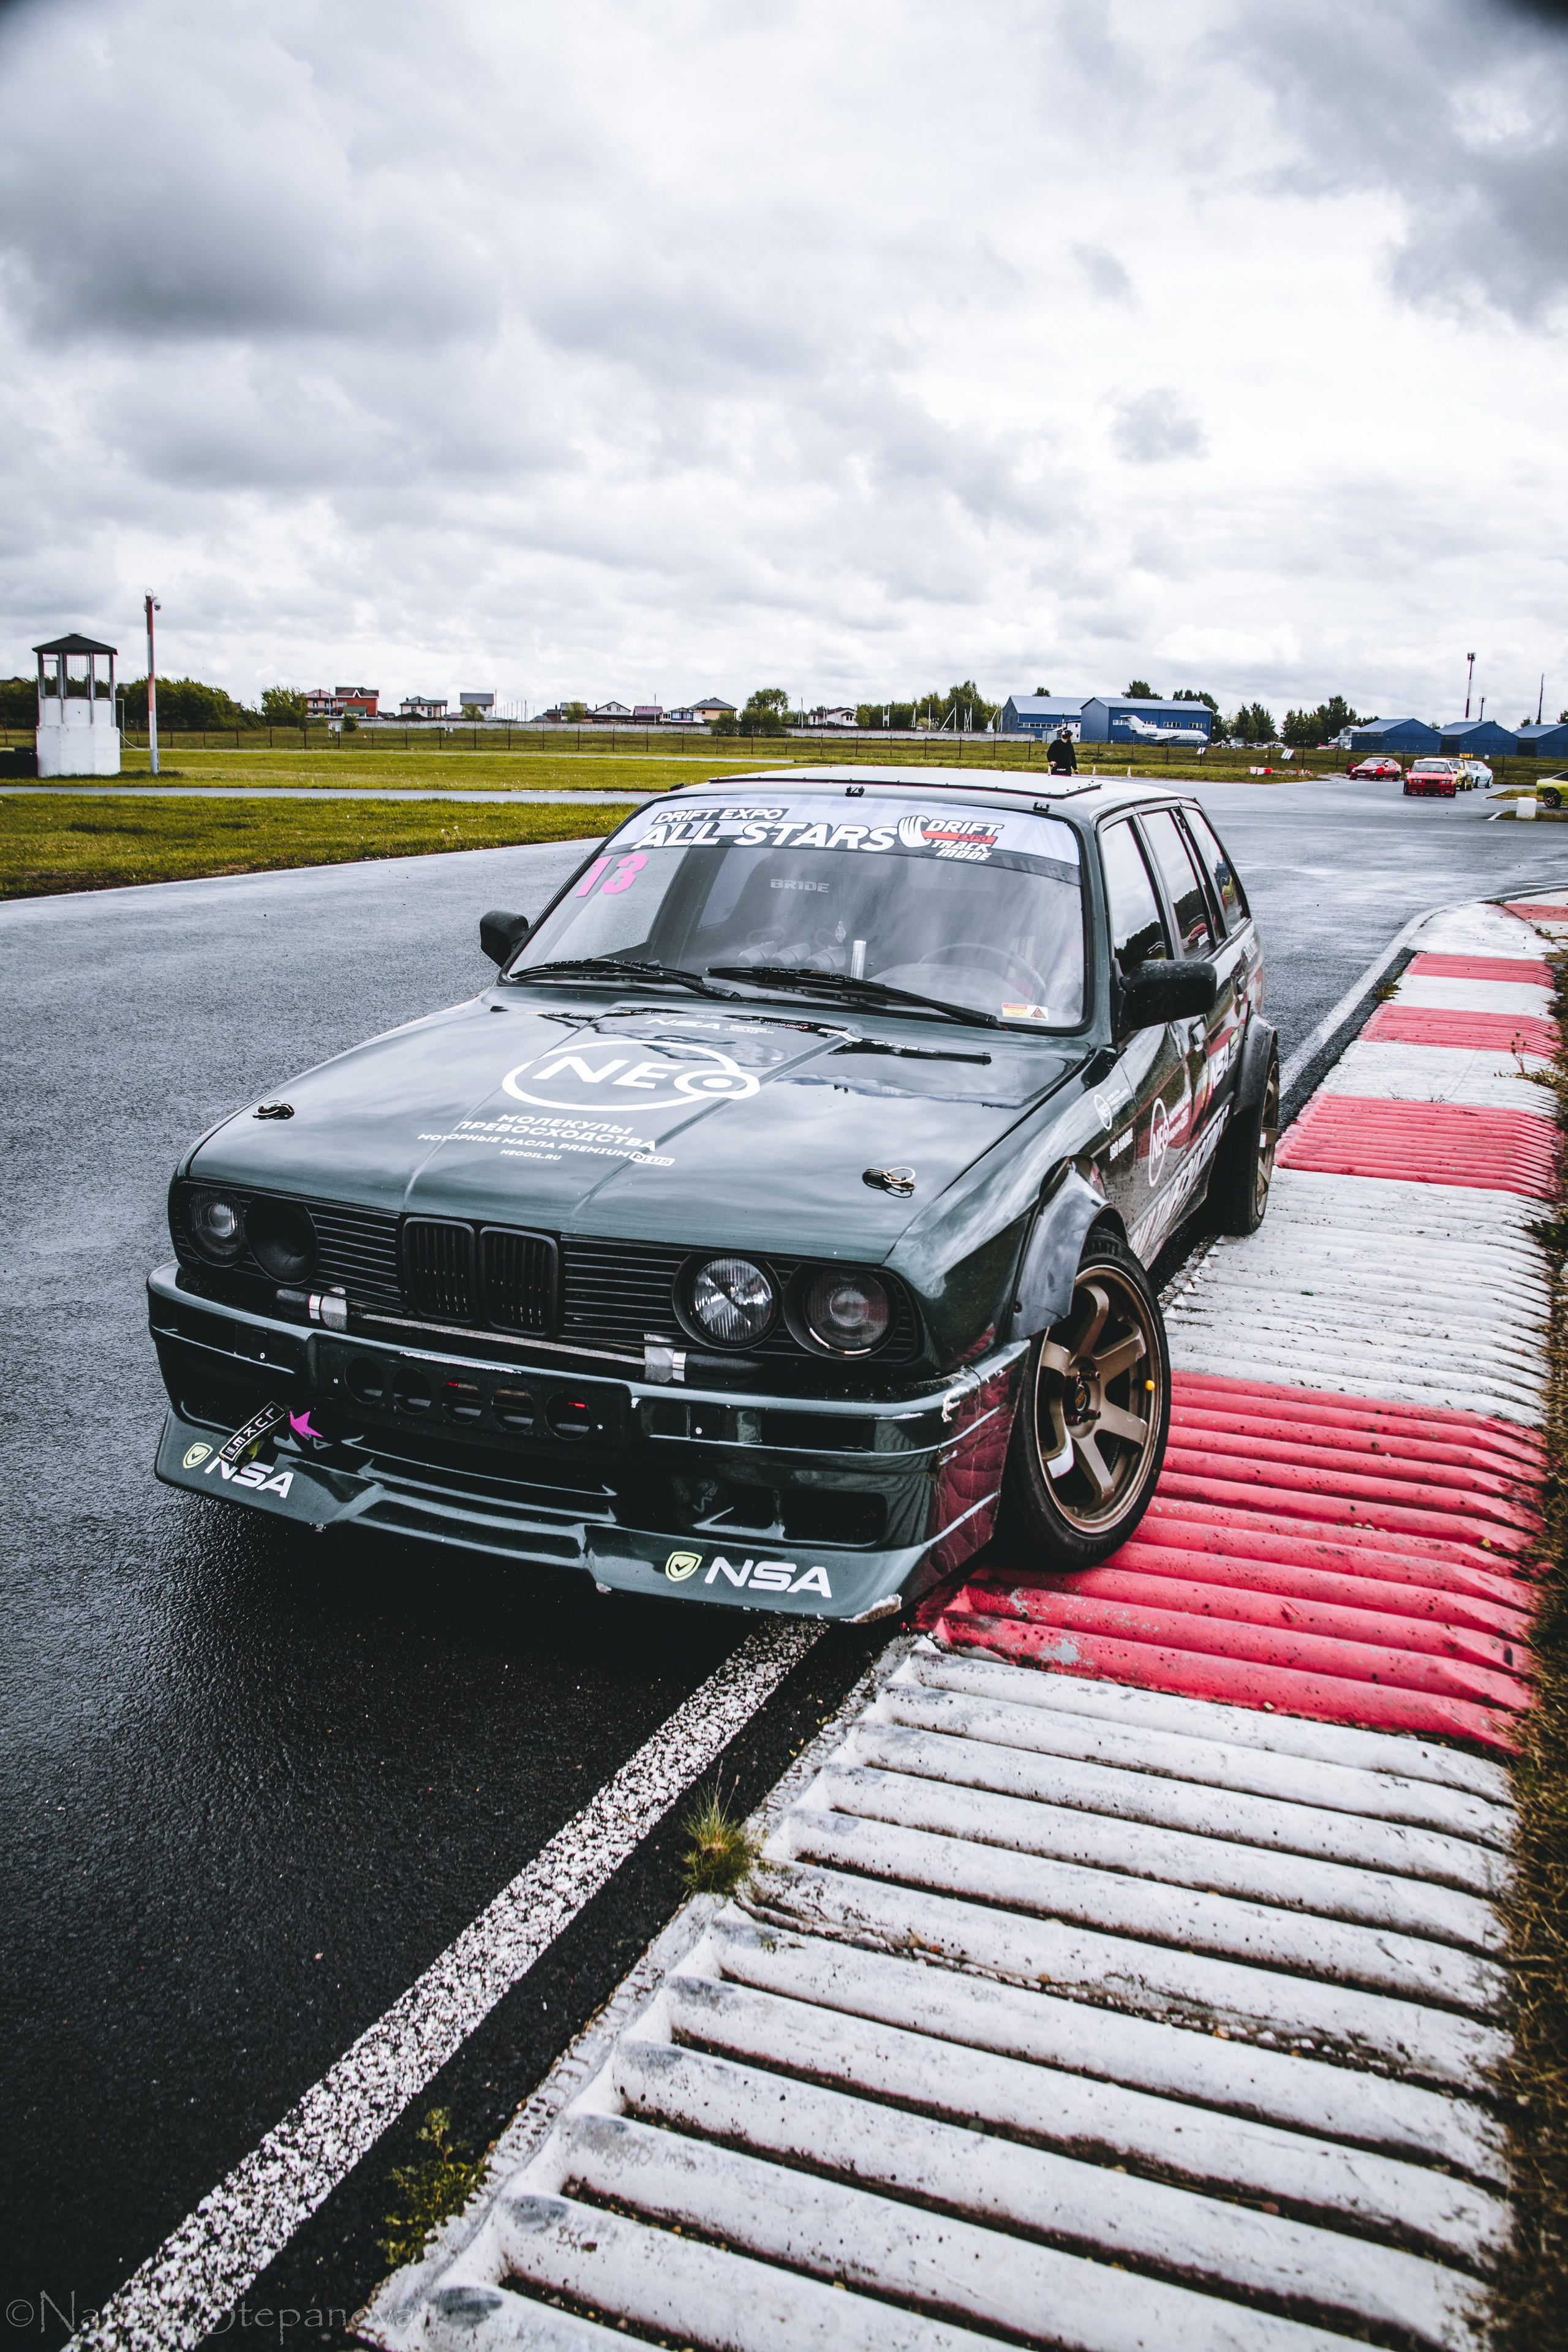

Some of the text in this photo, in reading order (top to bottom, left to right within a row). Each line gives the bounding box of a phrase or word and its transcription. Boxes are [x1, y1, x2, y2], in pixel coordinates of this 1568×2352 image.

[654, 809, 783, 824] DRIFT EXPO
[925, 820, 1003, 836] DRIFT
[630, 821, 899, 851] ALL STARS
[575, 854, 649, 899] 13
[770, 878, 830, 893] BRIDE
[644, 1019, 720, 1030] NSA
[532, 1056, 761, 1100] NEO
[453, 1121, 657, 1152] ПРЕВОСХОДСТВА
[497, 1114, 634, 1134] МОЛЕКУЛЫ
[417, 1133, 673, 1166] МОТОРНЫЕ МАСЛА PREMIUM PLUS
[500, 1149, 562, 1161] NEOOIL.RU
[204, 1457, 294, 1498] NSA
[704, 1556, 832, 1598] NSA
